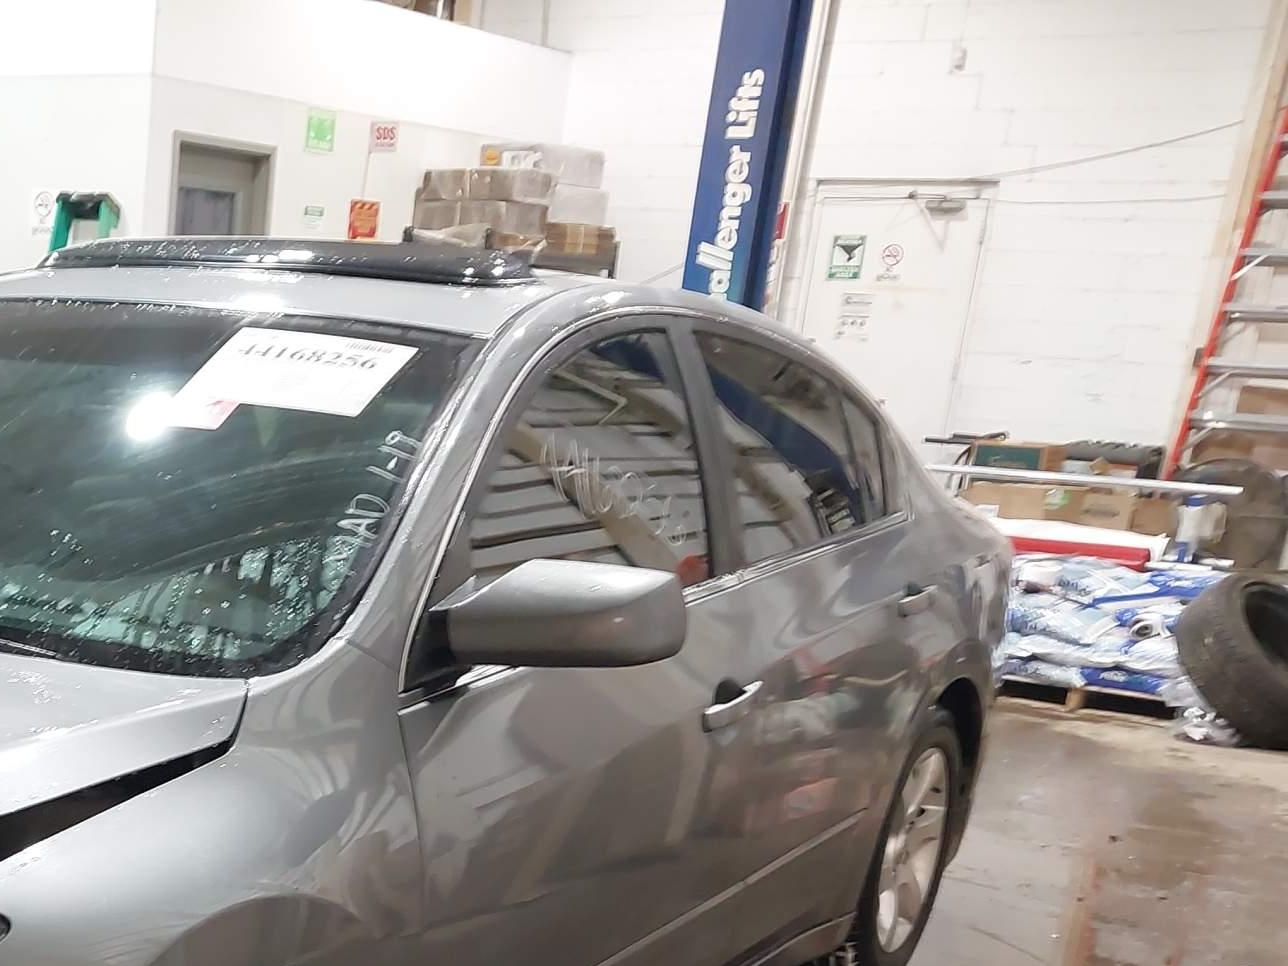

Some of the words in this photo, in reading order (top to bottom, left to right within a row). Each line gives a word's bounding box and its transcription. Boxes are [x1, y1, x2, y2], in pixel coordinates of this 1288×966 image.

[724, 68, 765, 140] Lifts
[375, 126, 397, 141] SDS
[696, 145, 753, 301] allenger
[238, 343, 379, 371] 44168256
[365, 429, 425, 484] 1-19
